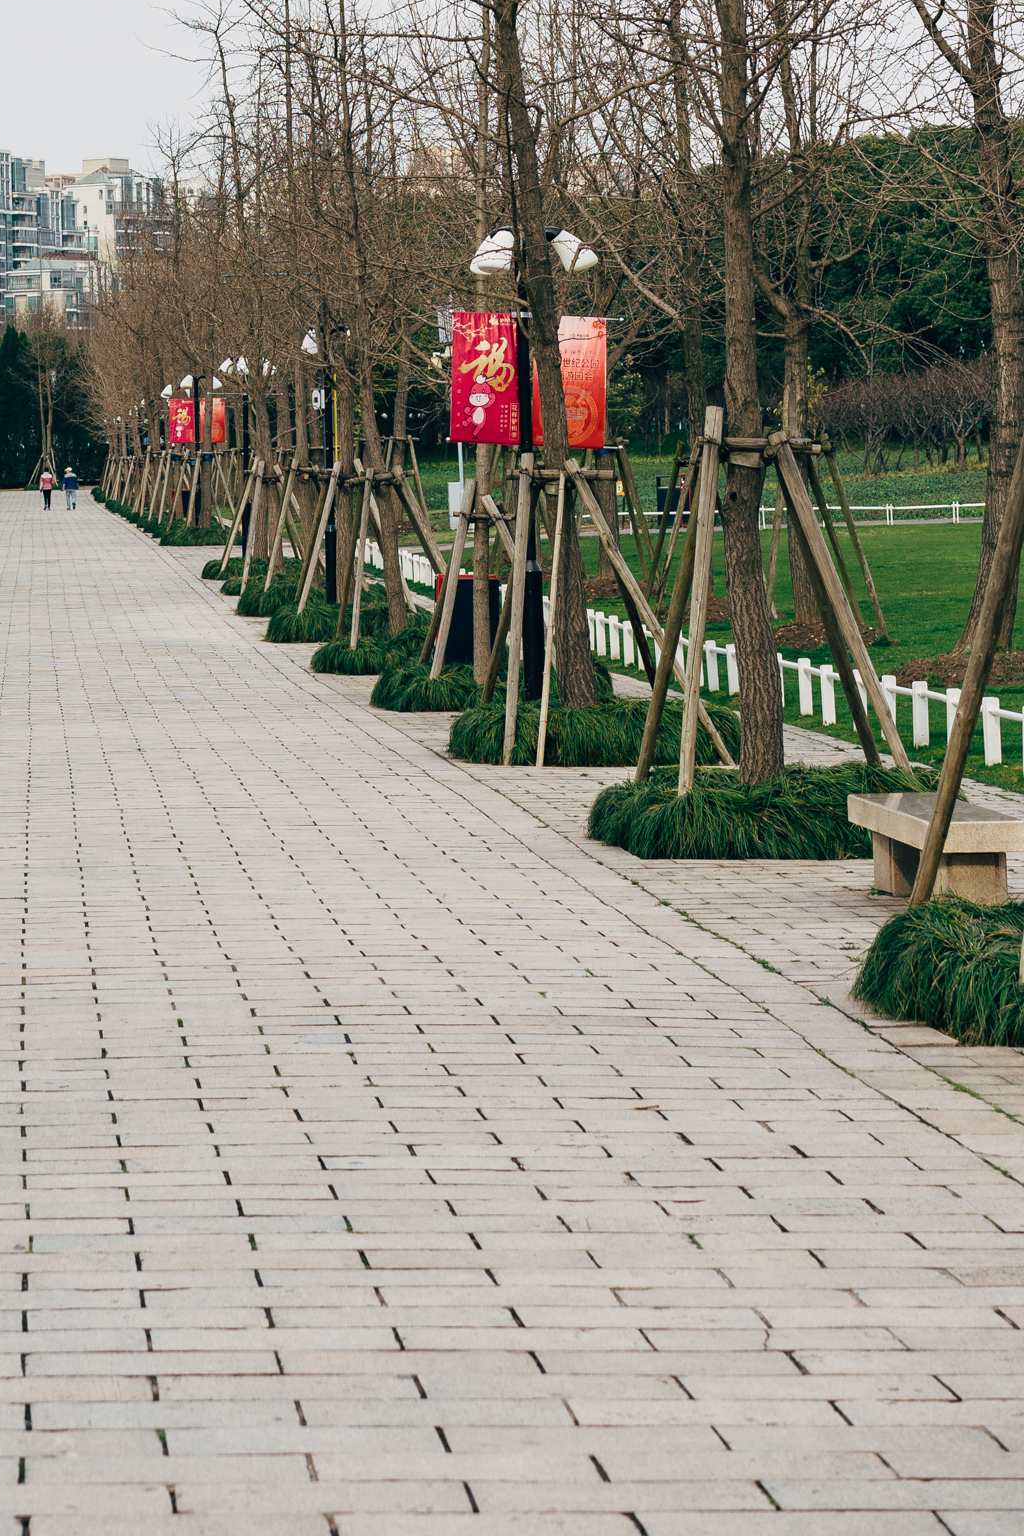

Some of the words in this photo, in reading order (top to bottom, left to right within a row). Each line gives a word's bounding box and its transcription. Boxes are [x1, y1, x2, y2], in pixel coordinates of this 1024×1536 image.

[459, 337, 515, 392] 福
[562, 357, 599, 369] 世纪公园
[172, 407, 191, 426] 福
